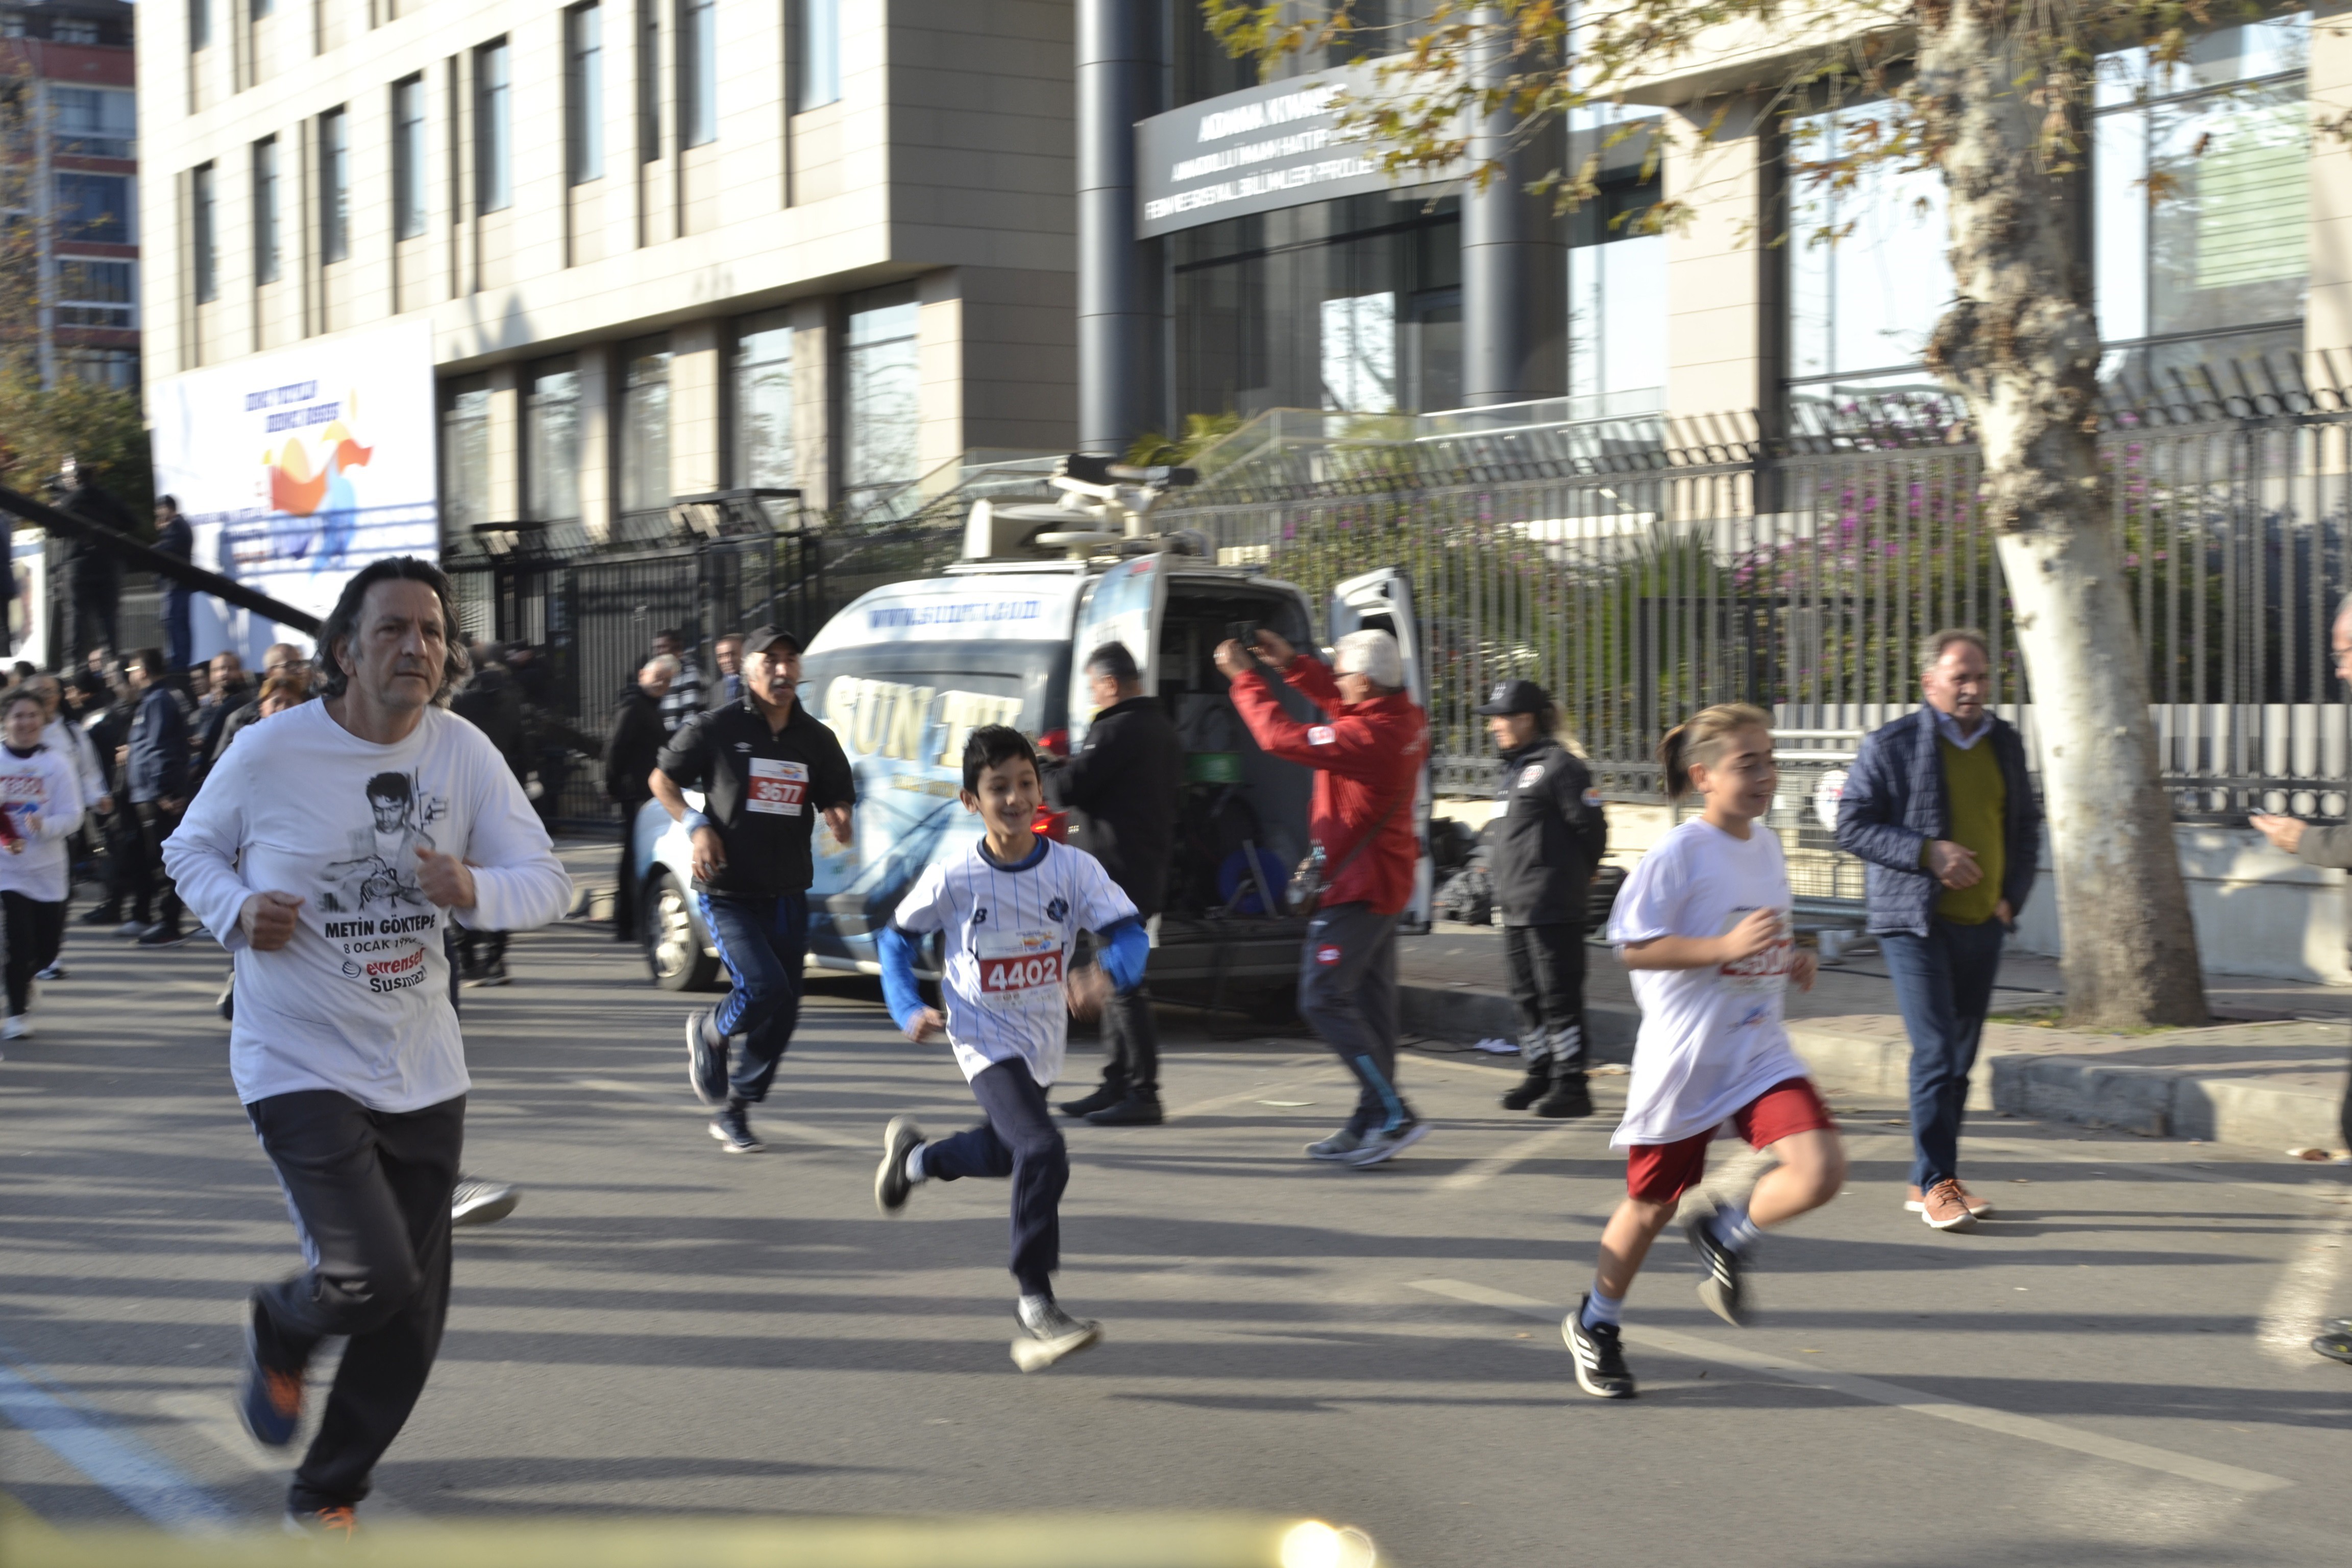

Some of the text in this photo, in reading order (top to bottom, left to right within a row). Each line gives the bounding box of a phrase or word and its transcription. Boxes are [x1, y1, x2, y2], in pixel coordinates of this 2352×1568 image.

[756, 781, 802, 802] 3677
[325, 914, 435, 938] METİN GÖKTEPE
[344, 943, 350, 954] 8
[354, 940, 390, 953] OCAK
[988, 956, 1057, 990] 4402
